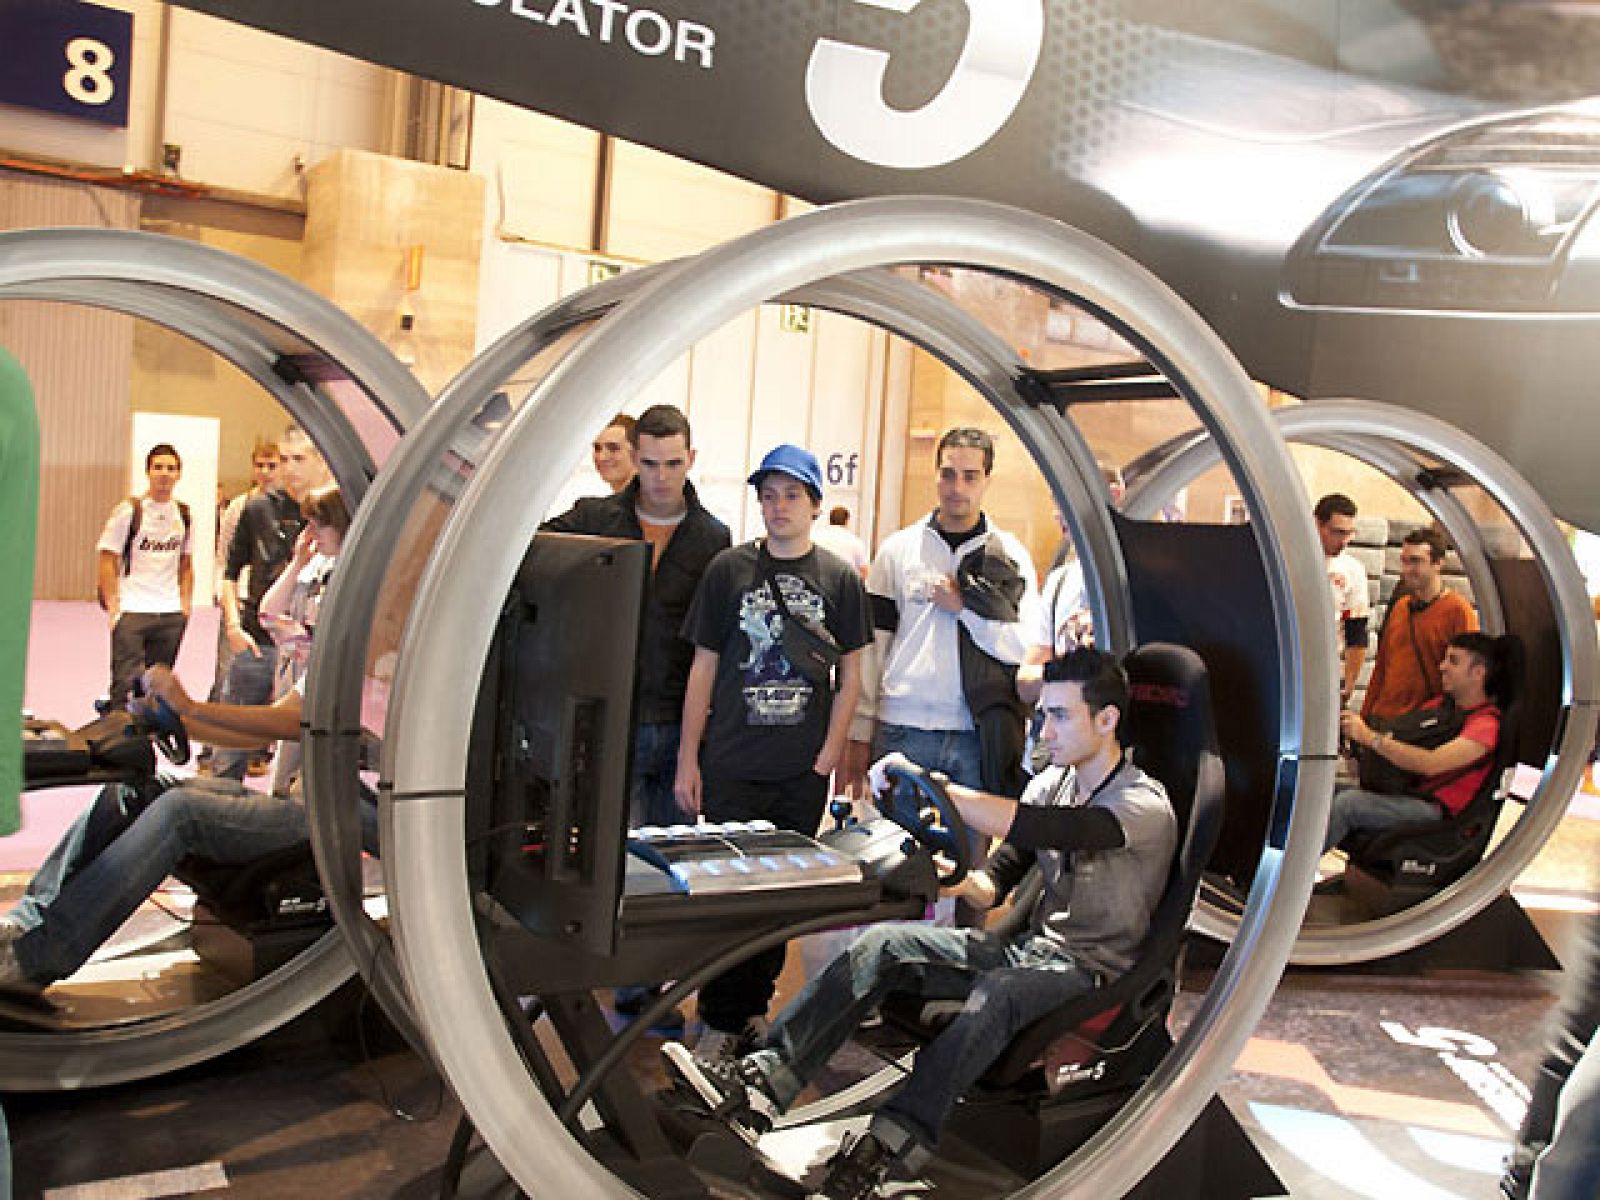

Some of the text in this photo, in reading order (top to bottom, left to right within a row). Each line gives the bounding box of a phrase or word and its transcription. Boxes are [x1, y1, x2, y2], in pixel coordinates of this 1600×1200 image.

[473, 0, 715, 68] LATOR
[63, 37, 114, 105] 8
[827, 453, 858, 485] 6f
